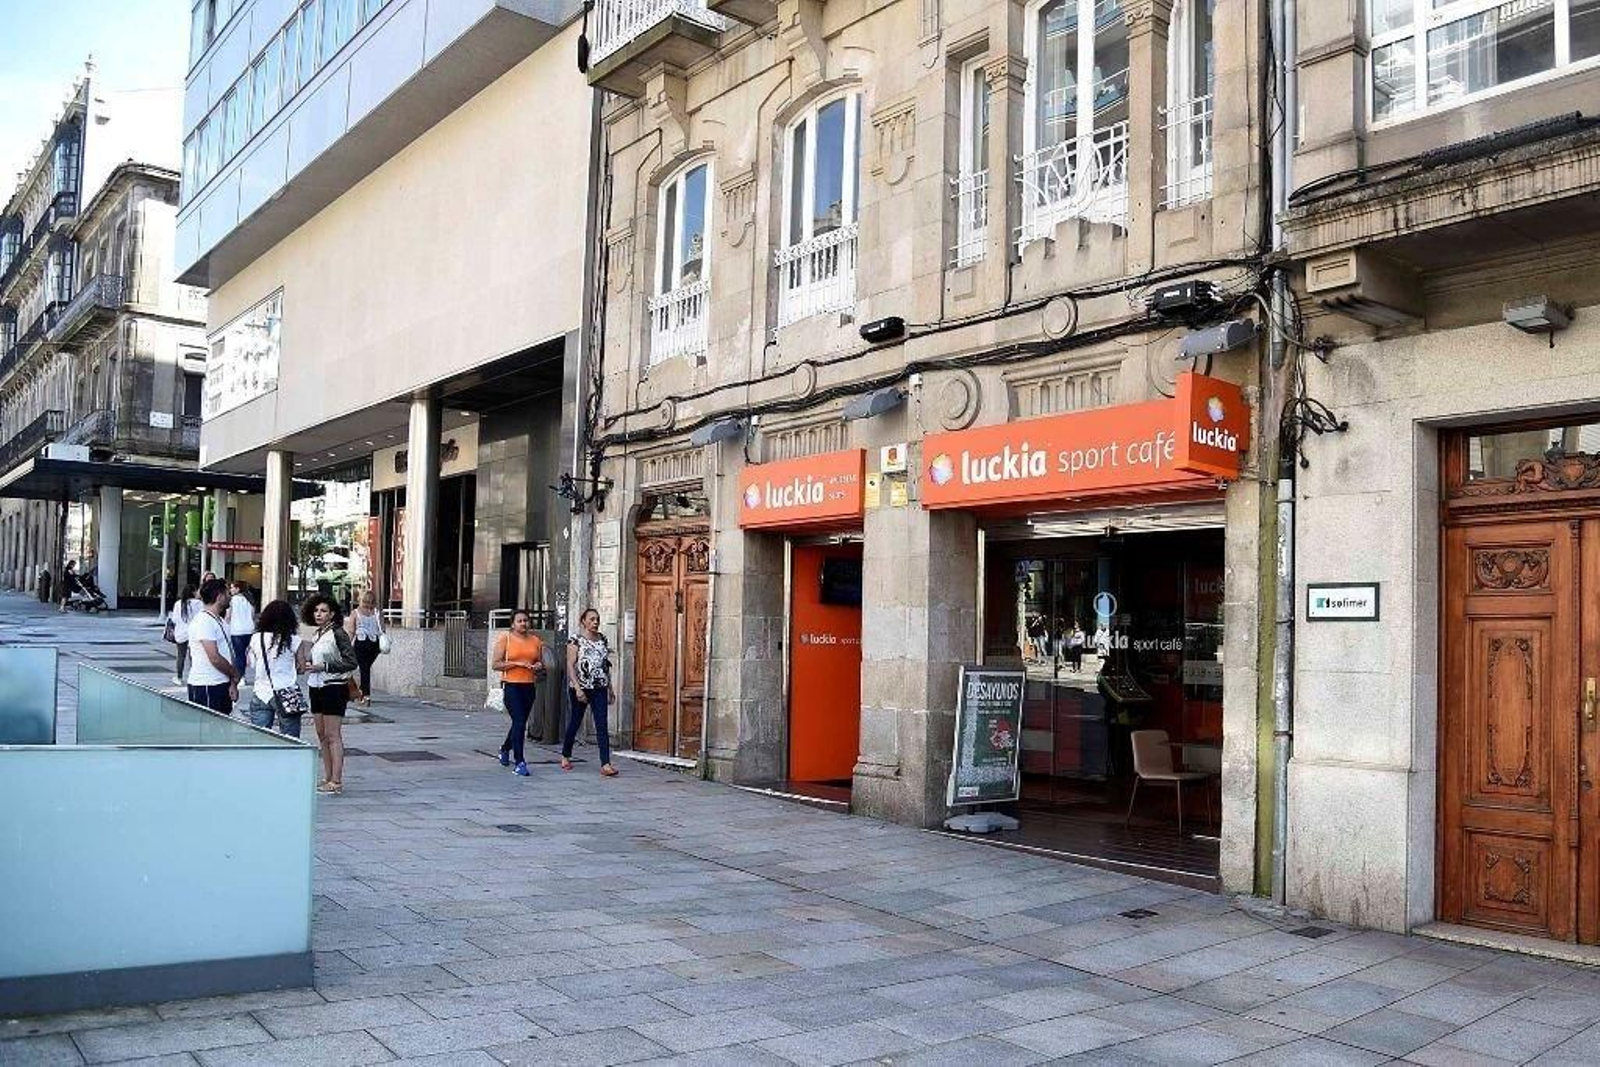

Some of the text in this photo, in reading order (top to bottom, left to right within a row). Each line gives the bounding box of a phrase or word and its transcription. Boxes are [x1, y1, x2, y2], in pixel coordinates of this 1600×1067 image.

[1192, 421, 1237, 451] luckia
[961, 429, 1176, 485] luckia sport café
[765, 475, 825, 509] luckia
[810, 633, 837, 645] luckia
[1082, 630, 1183, 653] lukia sport café
[966, 682, 1020, 700] DESAYUNOS
